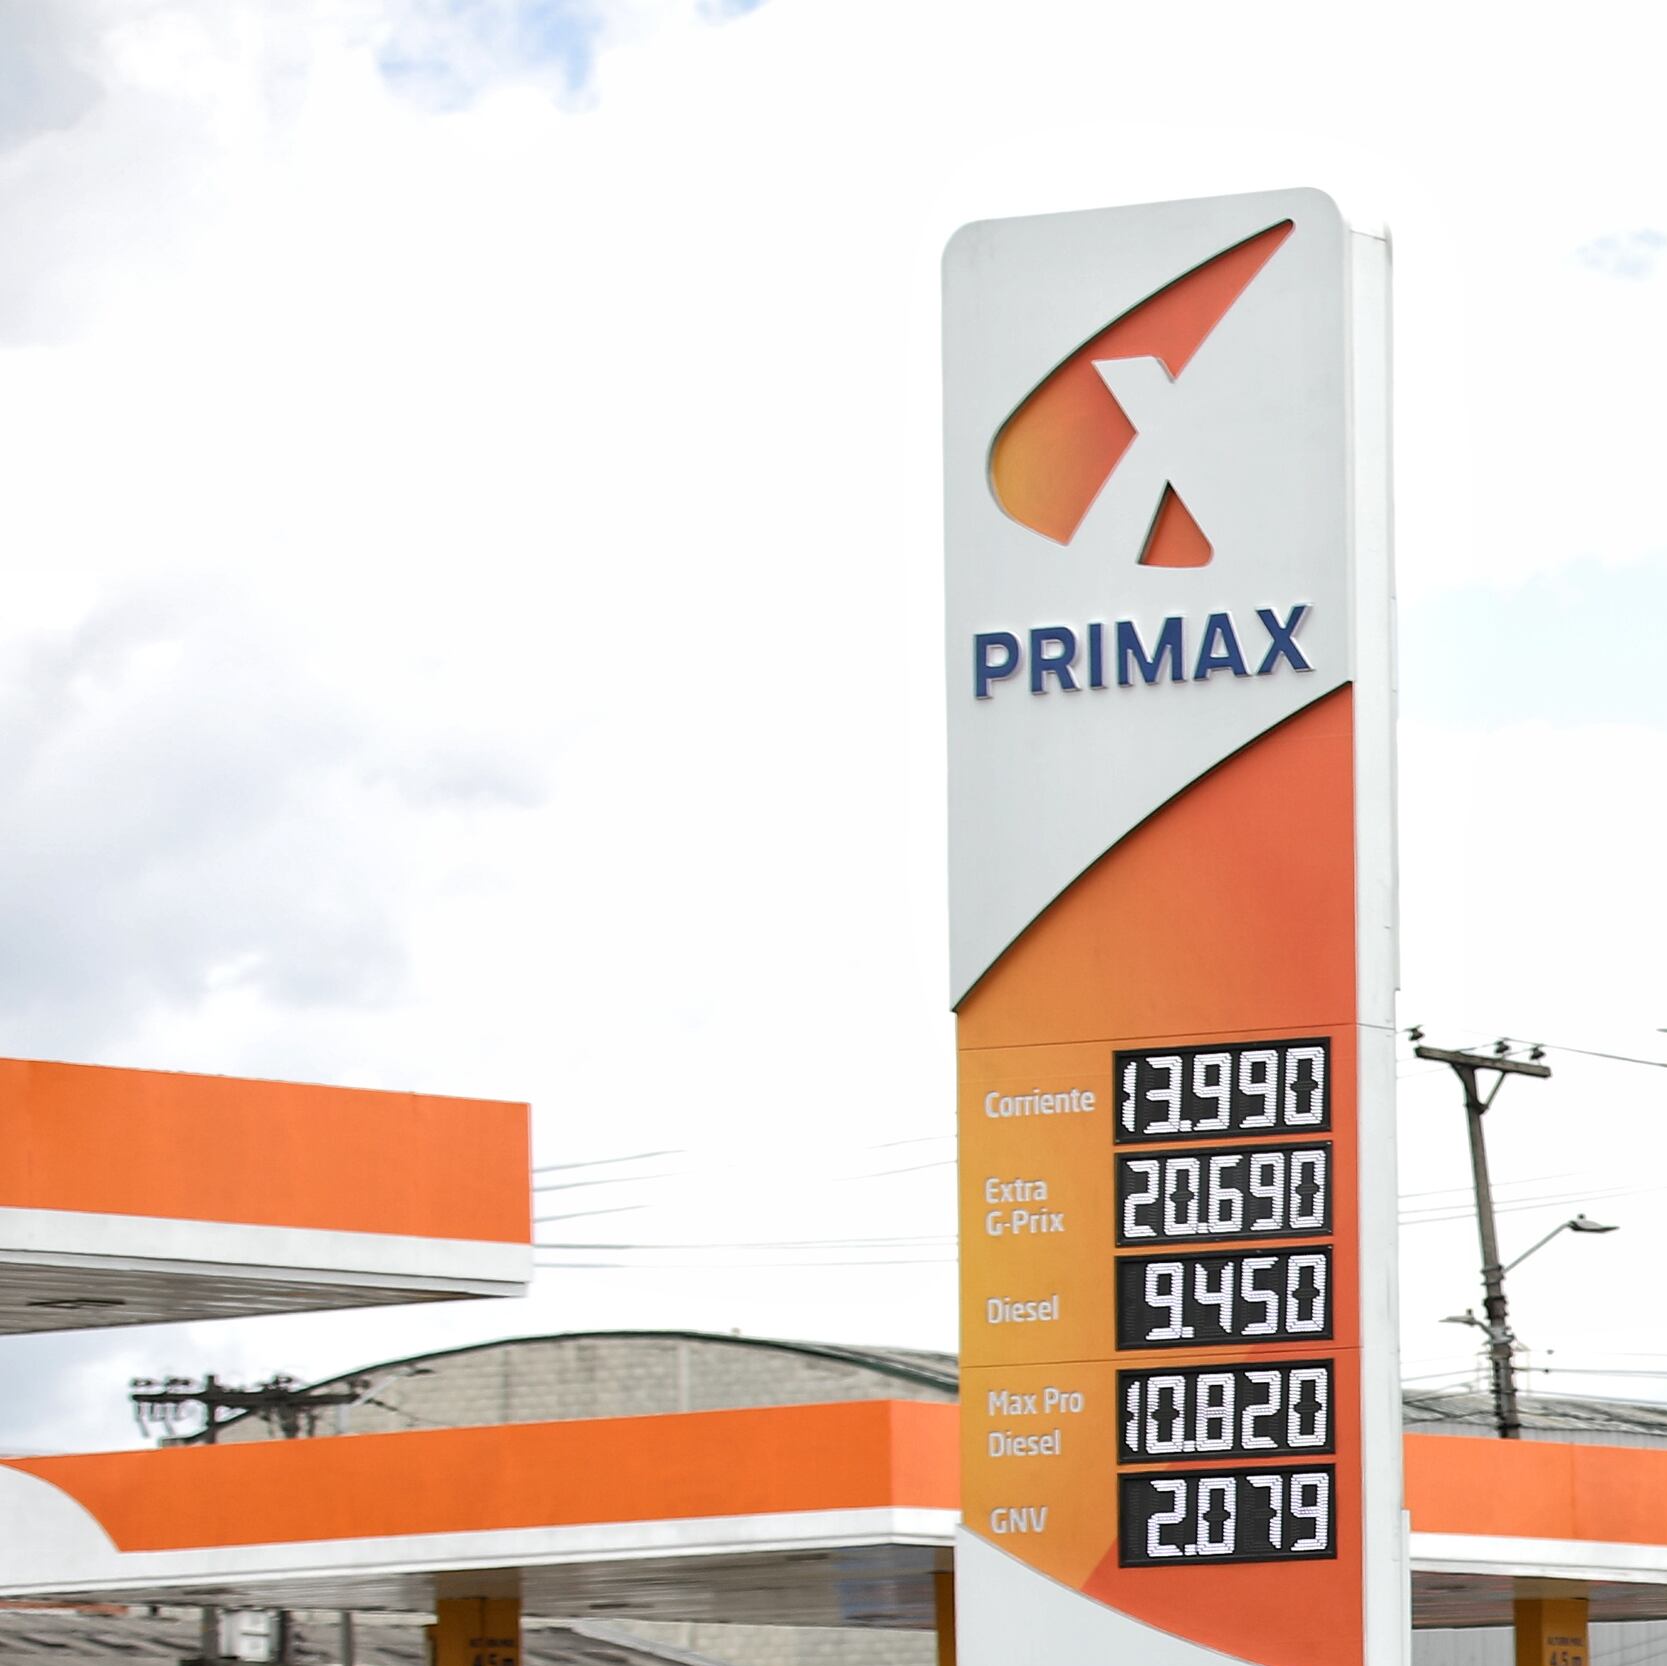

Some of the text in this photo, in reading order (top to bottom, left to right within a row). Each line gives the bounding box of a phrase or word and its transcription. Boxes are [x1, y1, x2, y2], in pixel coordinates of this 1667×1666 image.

[974, 604, 1316, 700] PRIMAX
[984, 1088, 1095, 1119] Corriente
[1121, 1046, 1324, 1134] 13.990
[985, 1177, 1049, 1204] Extra
[1123, 1149, 1327, 1238] 20.690
[985, 1209, 1065, 1237] G-Prix
[987, 1294, 1060, 1325] Diesel
[1144, 1253, 1327, 1341] 9.450
[988, 1387, 1084, 1416] Max Pro
[1125, 1367, 1328, 1455] 10.820
[988, 1429, 1062, 1459] Diesel
[989, 1506, 1048, 1535] GNV
[1146, 1471, 1330, 1557] 2.079
